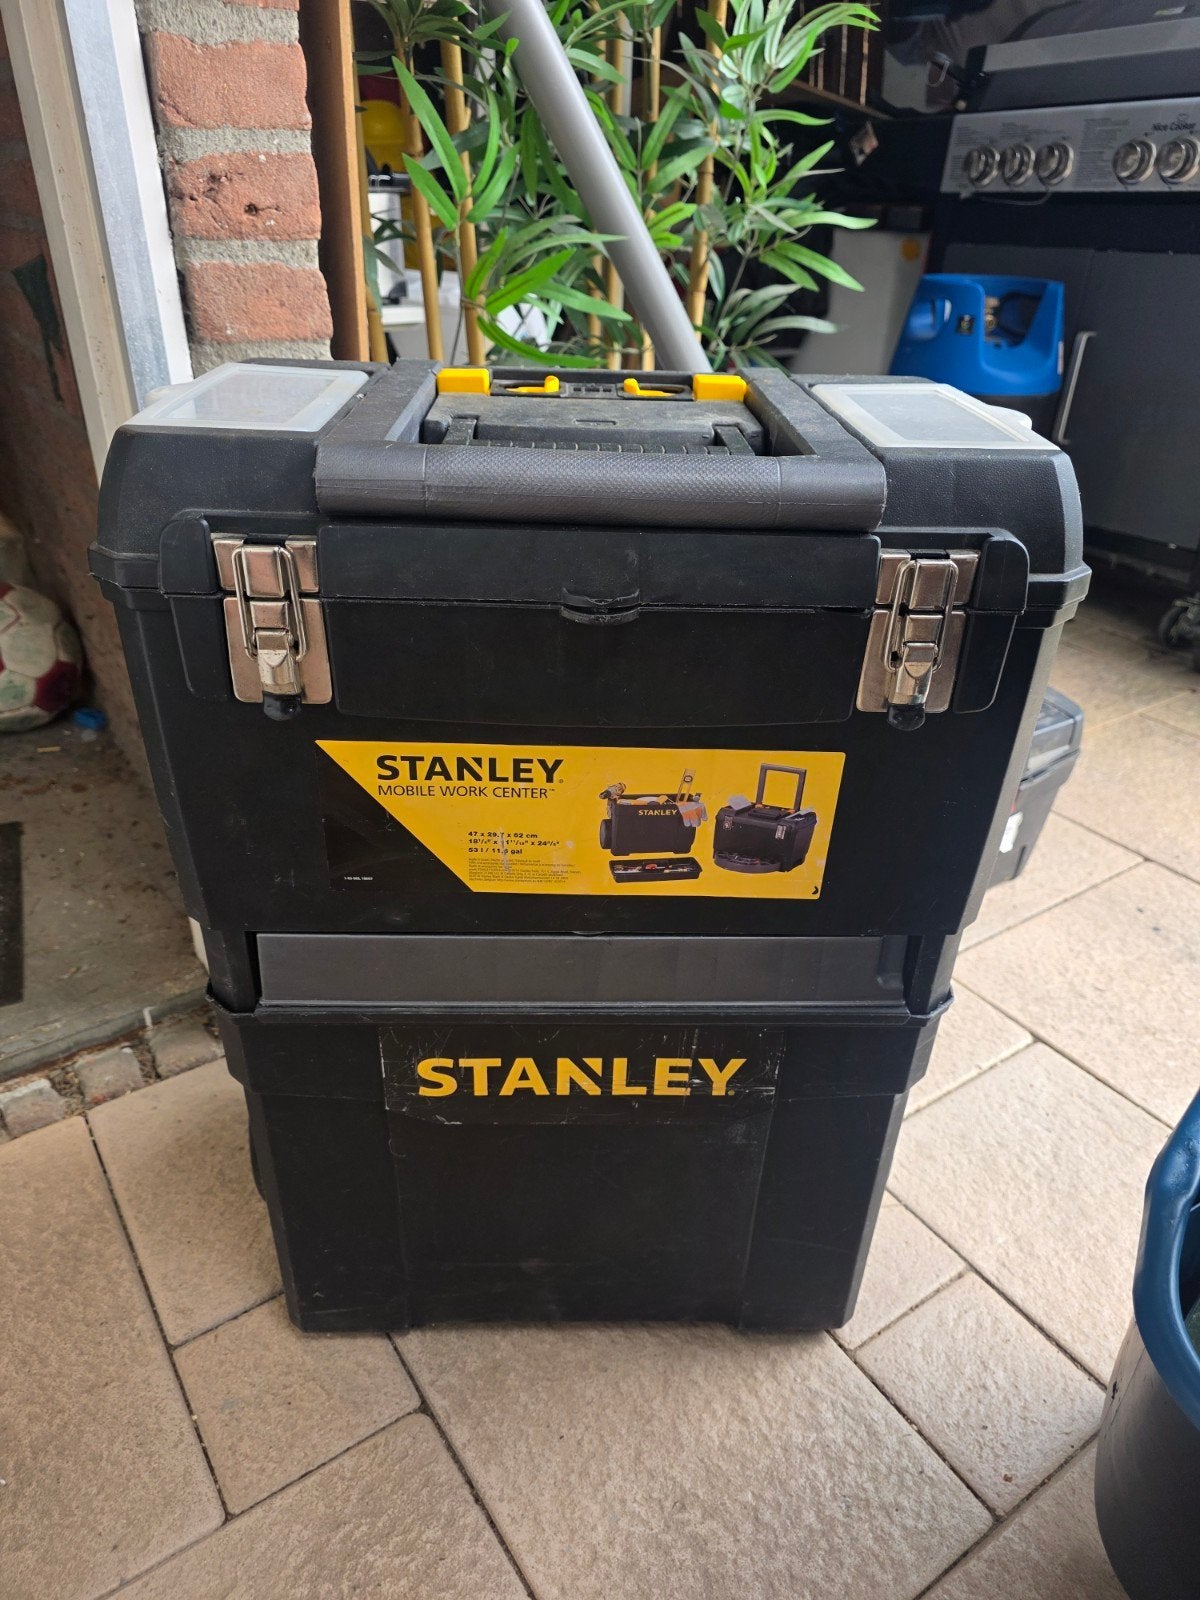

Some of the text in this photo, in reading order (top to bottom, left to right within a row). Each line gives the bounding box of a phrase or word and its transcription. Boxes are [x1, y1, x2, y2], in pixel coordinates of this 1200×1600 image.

[376, 754, 564, 783] STANLEY
[378, 785, 435, 796] MOBILE
[440, 786, 488, 797] WORK
[416, 1057, 747, 1097] STANLEY
